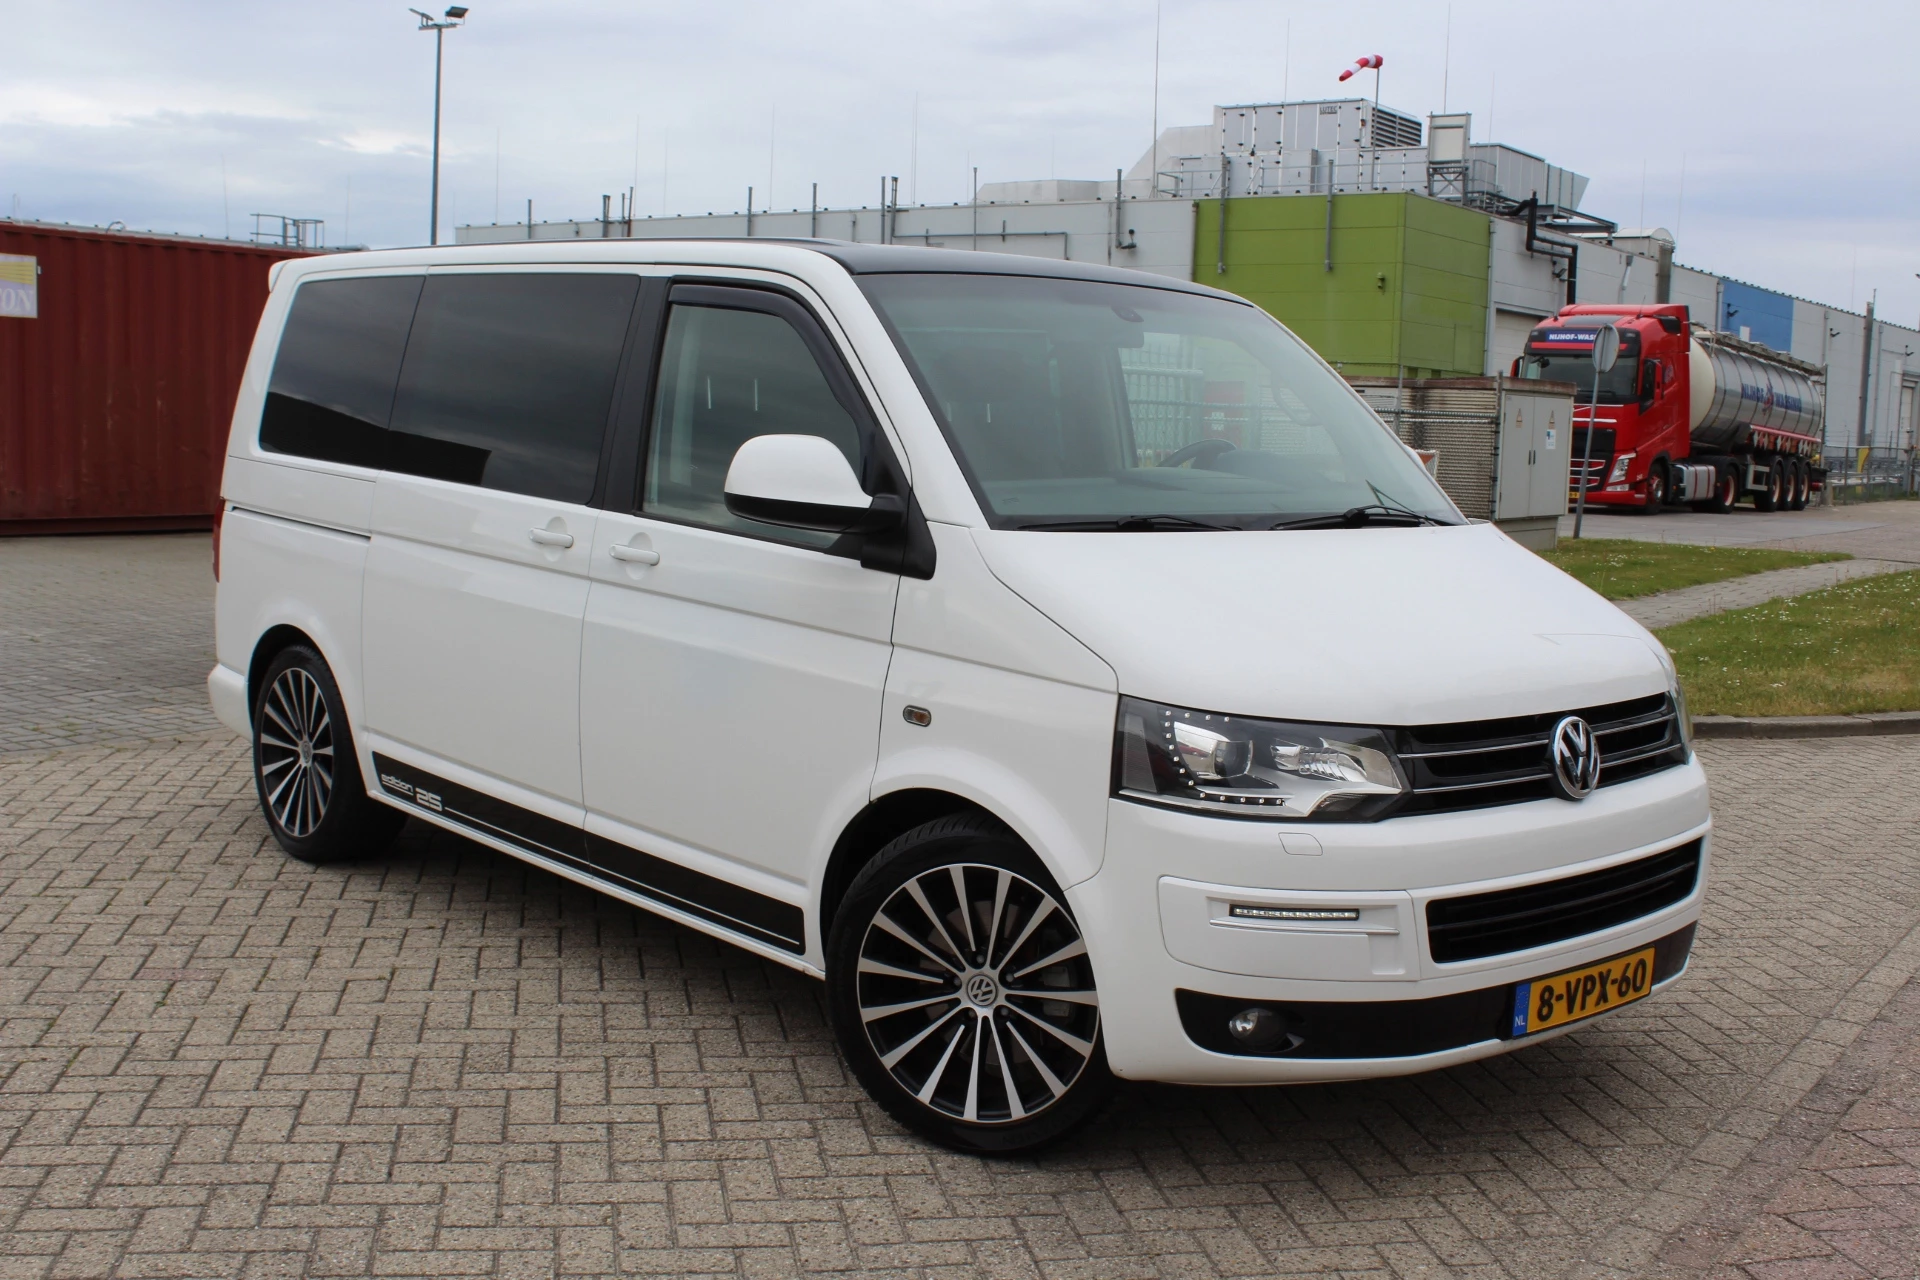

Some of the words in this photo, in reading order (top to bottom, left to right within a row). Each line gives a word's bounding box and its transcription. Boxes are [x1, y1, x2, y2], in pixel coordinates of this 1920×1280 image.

[0, 288, 34, 311] ON
[415, 787, 442, 811] 25
[1537, 958, 1647, 1022] 8-VPX-60
[1514, 1015, 1526, 1027] NL
